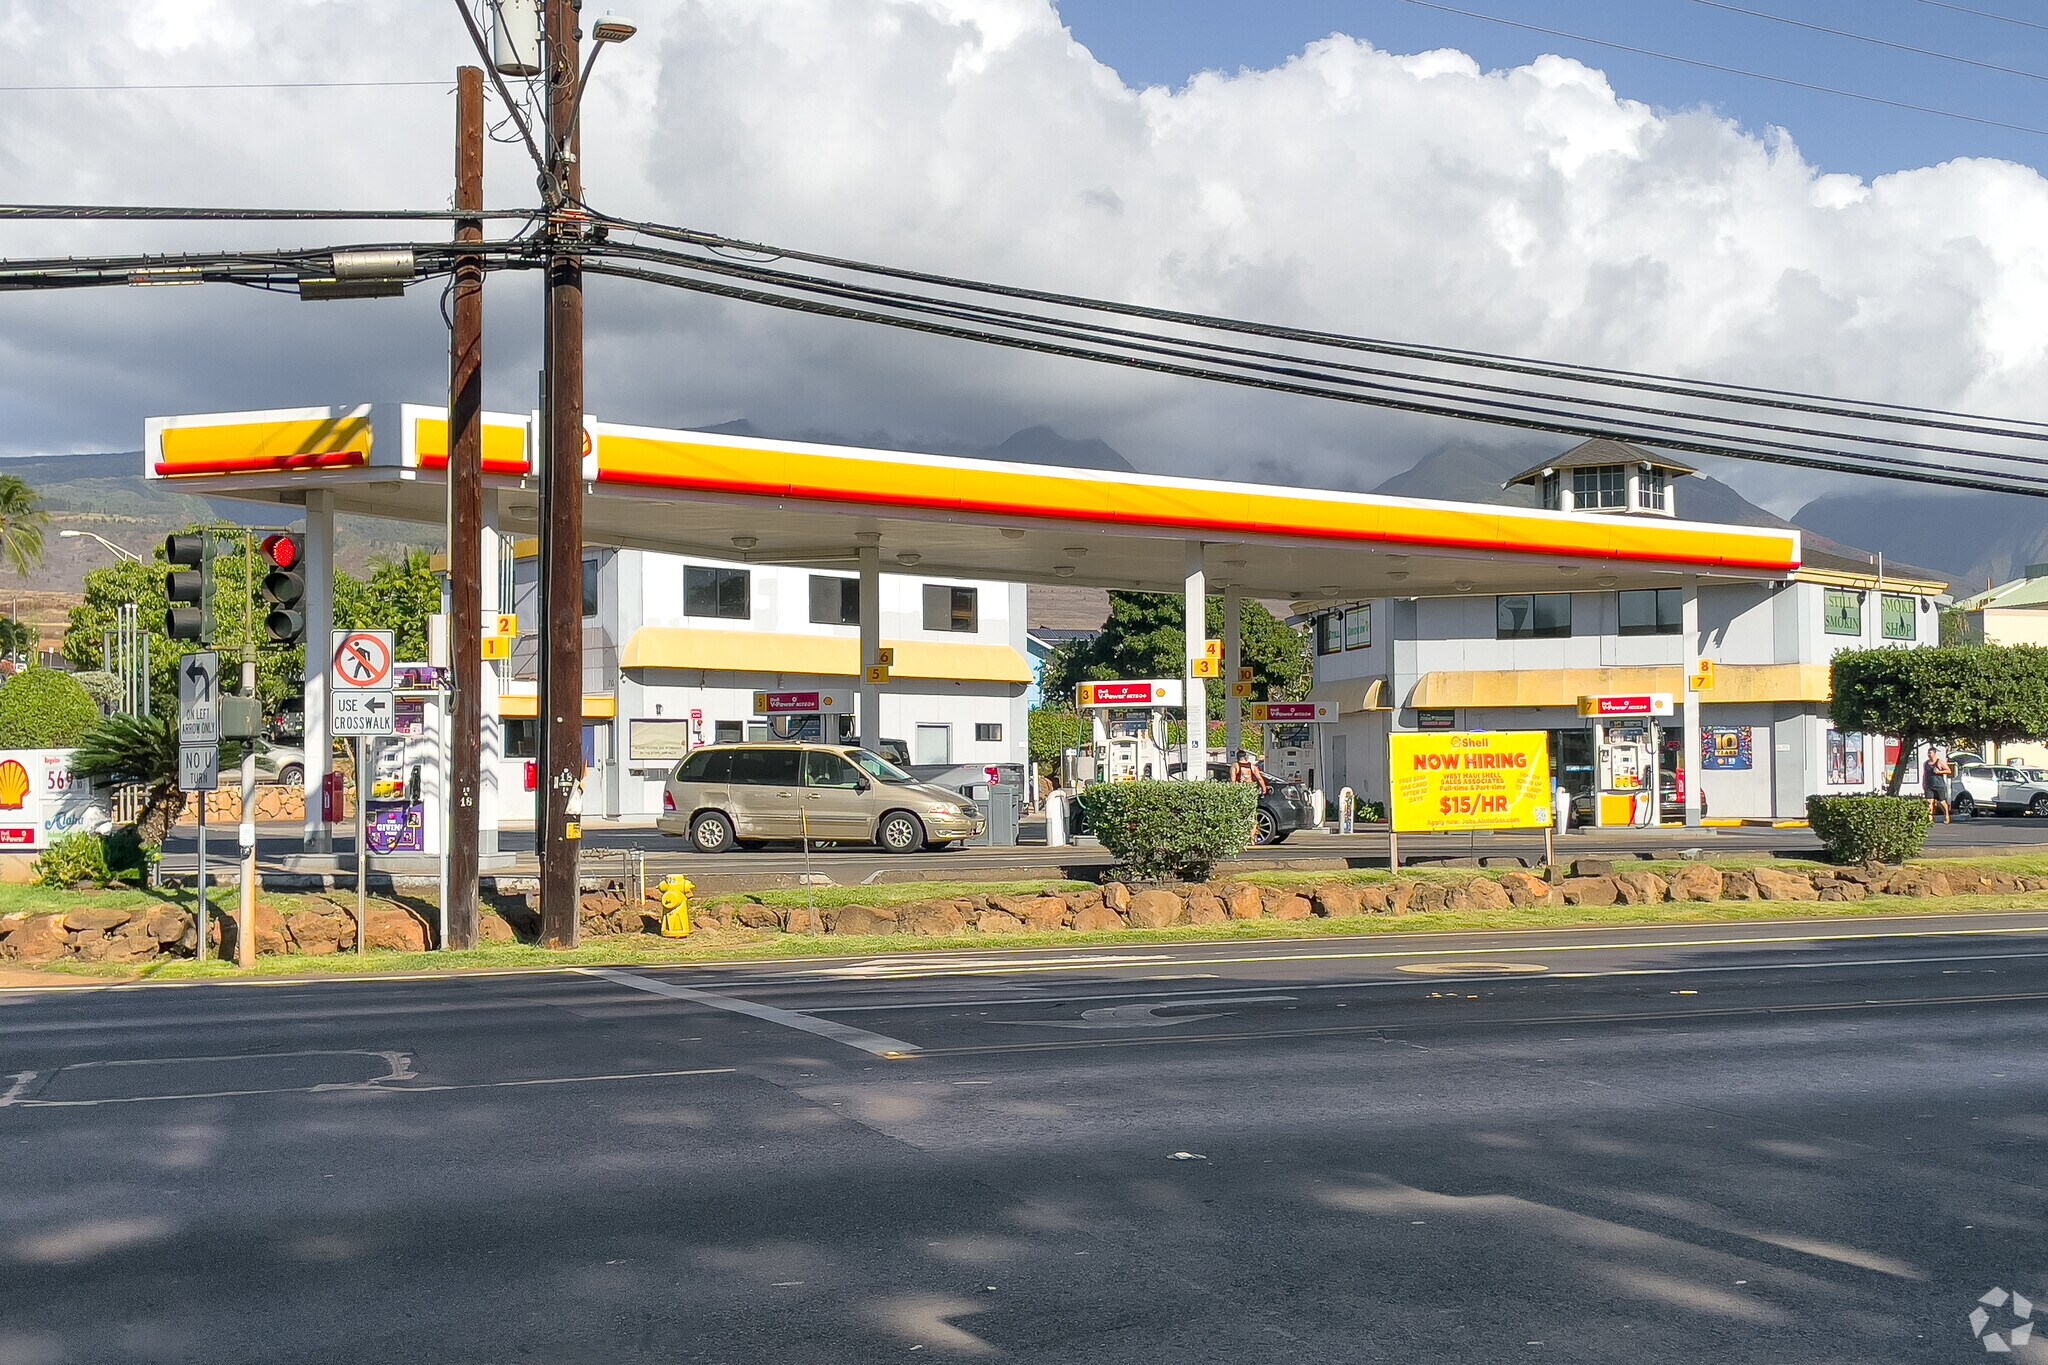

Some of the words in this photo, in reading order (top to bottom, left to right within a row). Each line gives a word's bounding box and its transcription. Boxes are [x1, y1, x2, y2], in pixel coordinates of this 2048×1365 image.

[1828, 595, 1854, 609] STILL
[1882, 598, 1914, 614] SMOKE
[499, 618, 509, 632] 2
[1886, 622, 1911, 637] SHOP
[488, 640, 494, 654] 1
[1207, 643, 1216, 654] 4
[880, 651, 889, 662] 6
[1200, 661, 1209, 673] 3
[1701, 661, 1709, 671] 8
[872, 669, 880, 680] 5
[1241, 670, 1252, 680] 10
[1697, 677, 1705, 687] 7
[1083, 690, 1090, 700] 3
[1236, 685, 1244, 695] 9
[1098, 692, 1125, 700] V-Power
[338, 699, 358, 712] USE
[758, 698, 763, 708] 5
[1586, 702, 1592, 711] 7
[186, 708, 195, 721] ON
[197, 708, 209, 720] LEFT
[1257, 708, 1262, 716] 9
[182, 723, 200, 735] ARROW
[201, 722, 215, 734] ONLY
[335, 716, 391, 730] CROSSWALK
[1462, 738, 1489, 748] Shell
[1715, 734, 1738, 750] 10
[186, 752, 200, 768] NO
[205, 752, 212, 768] U
[1413, 754, 1460, 770] NOW
[1464, 752, 1527, 769] HIRING
[190, 772, 208, 784] TURN
[560, 771, 573, 782] 18
[460, 796, 473, 807] 18
[1439, 794, 1508, 816] $15/HR
